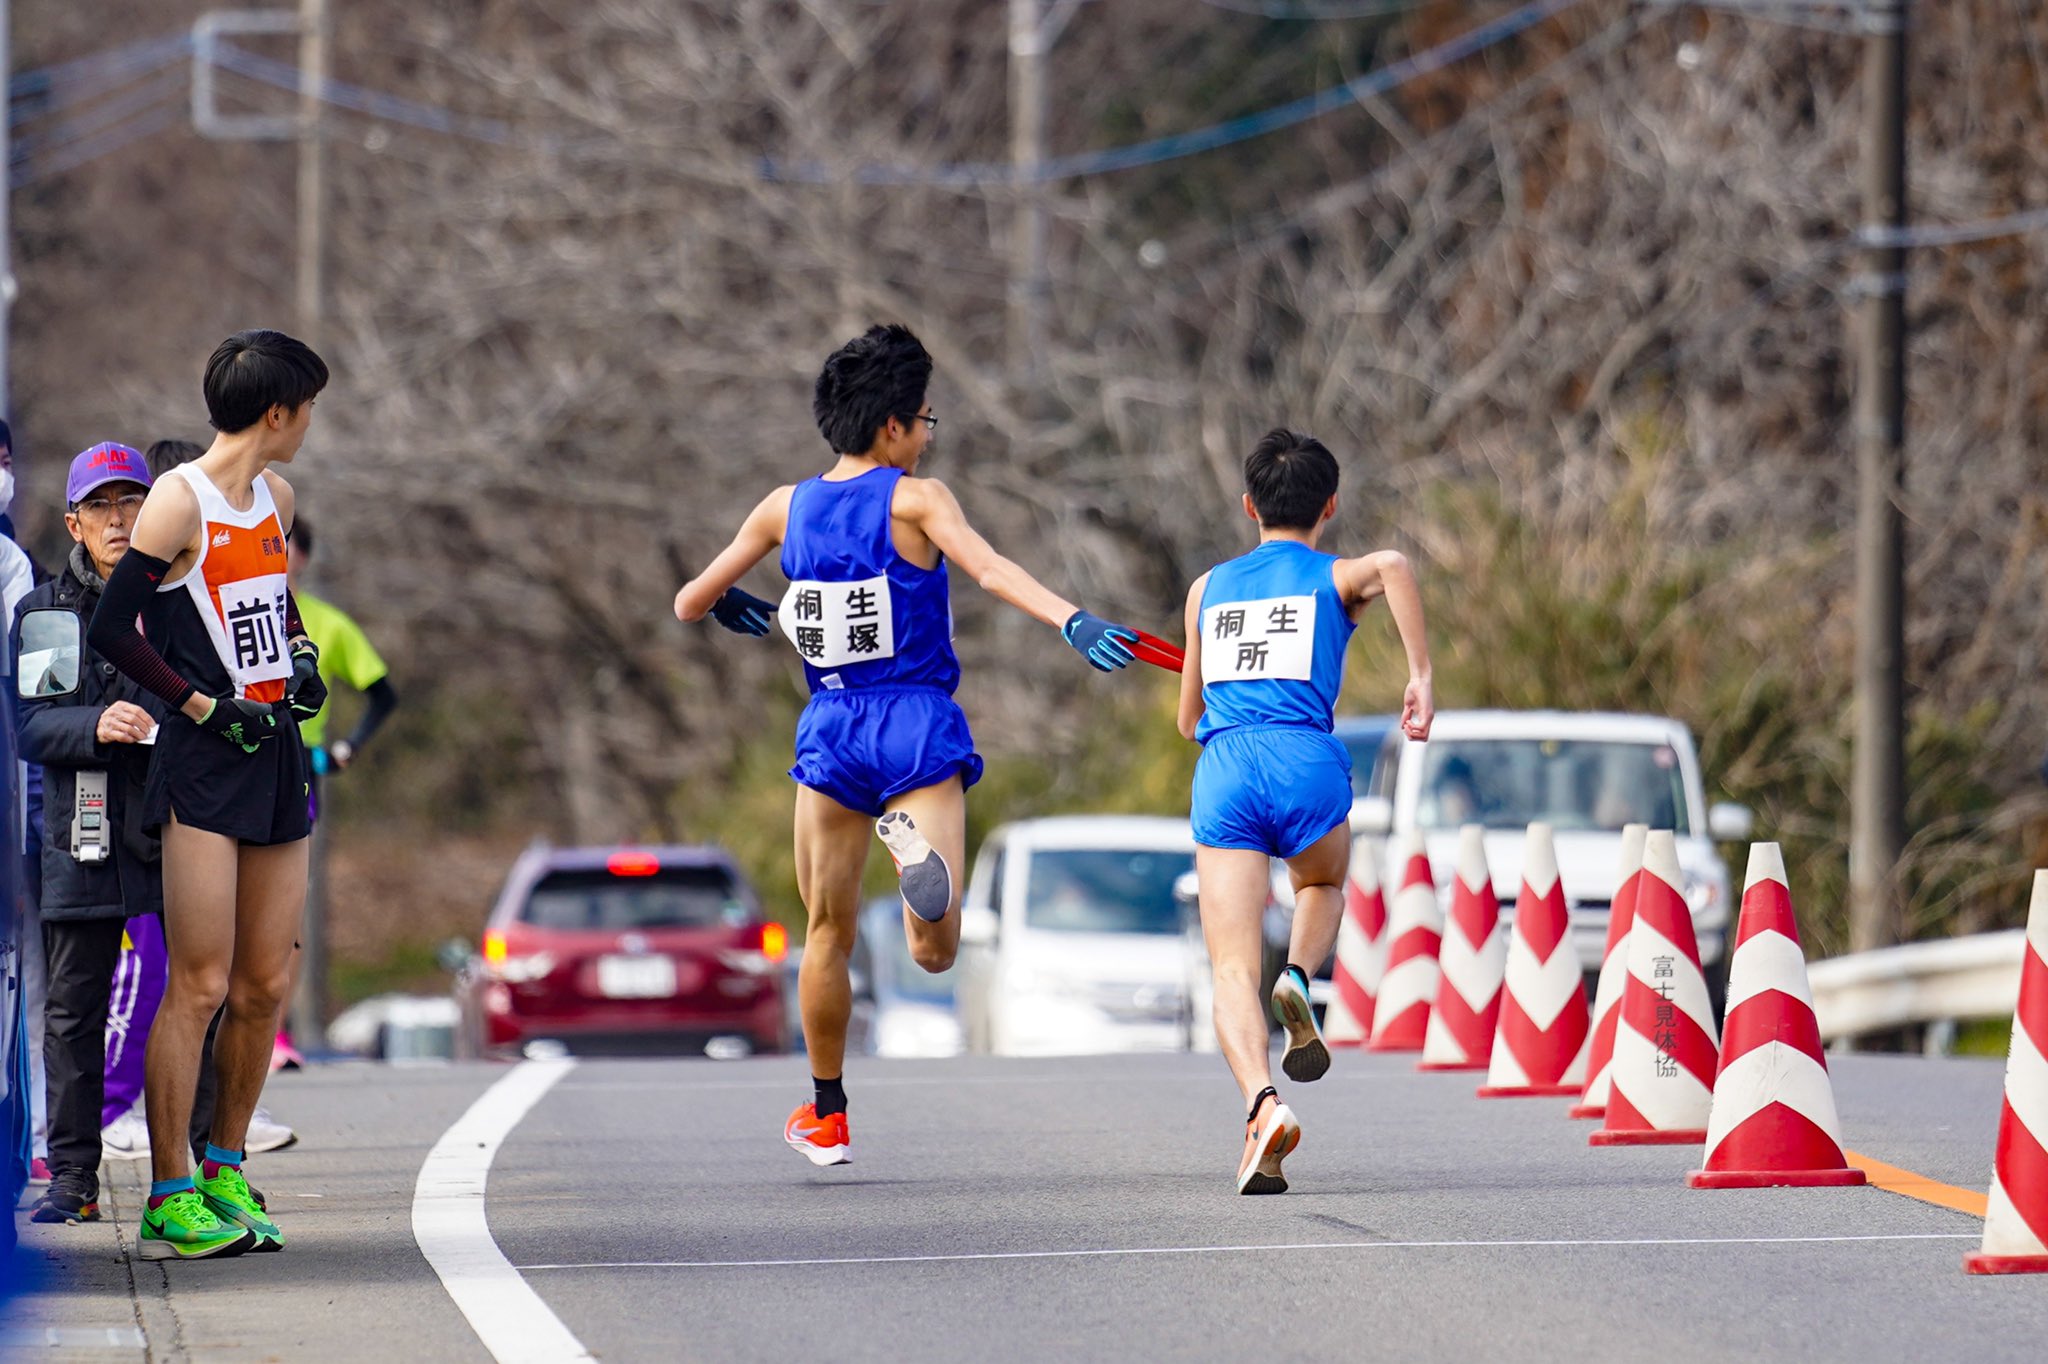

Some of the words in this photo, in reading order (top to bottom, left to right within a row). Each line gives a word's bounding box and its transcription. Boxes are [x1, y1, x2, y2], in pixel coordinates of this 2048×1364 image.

[794, 587, 878, 621] 桐生
[1214, 603, 1298, 640] 桐生
[228, 592, 287, 669] 前
[1235, 640, 1269, 672] 所
[1652, 955, 1678, 1078] 富士見体協
